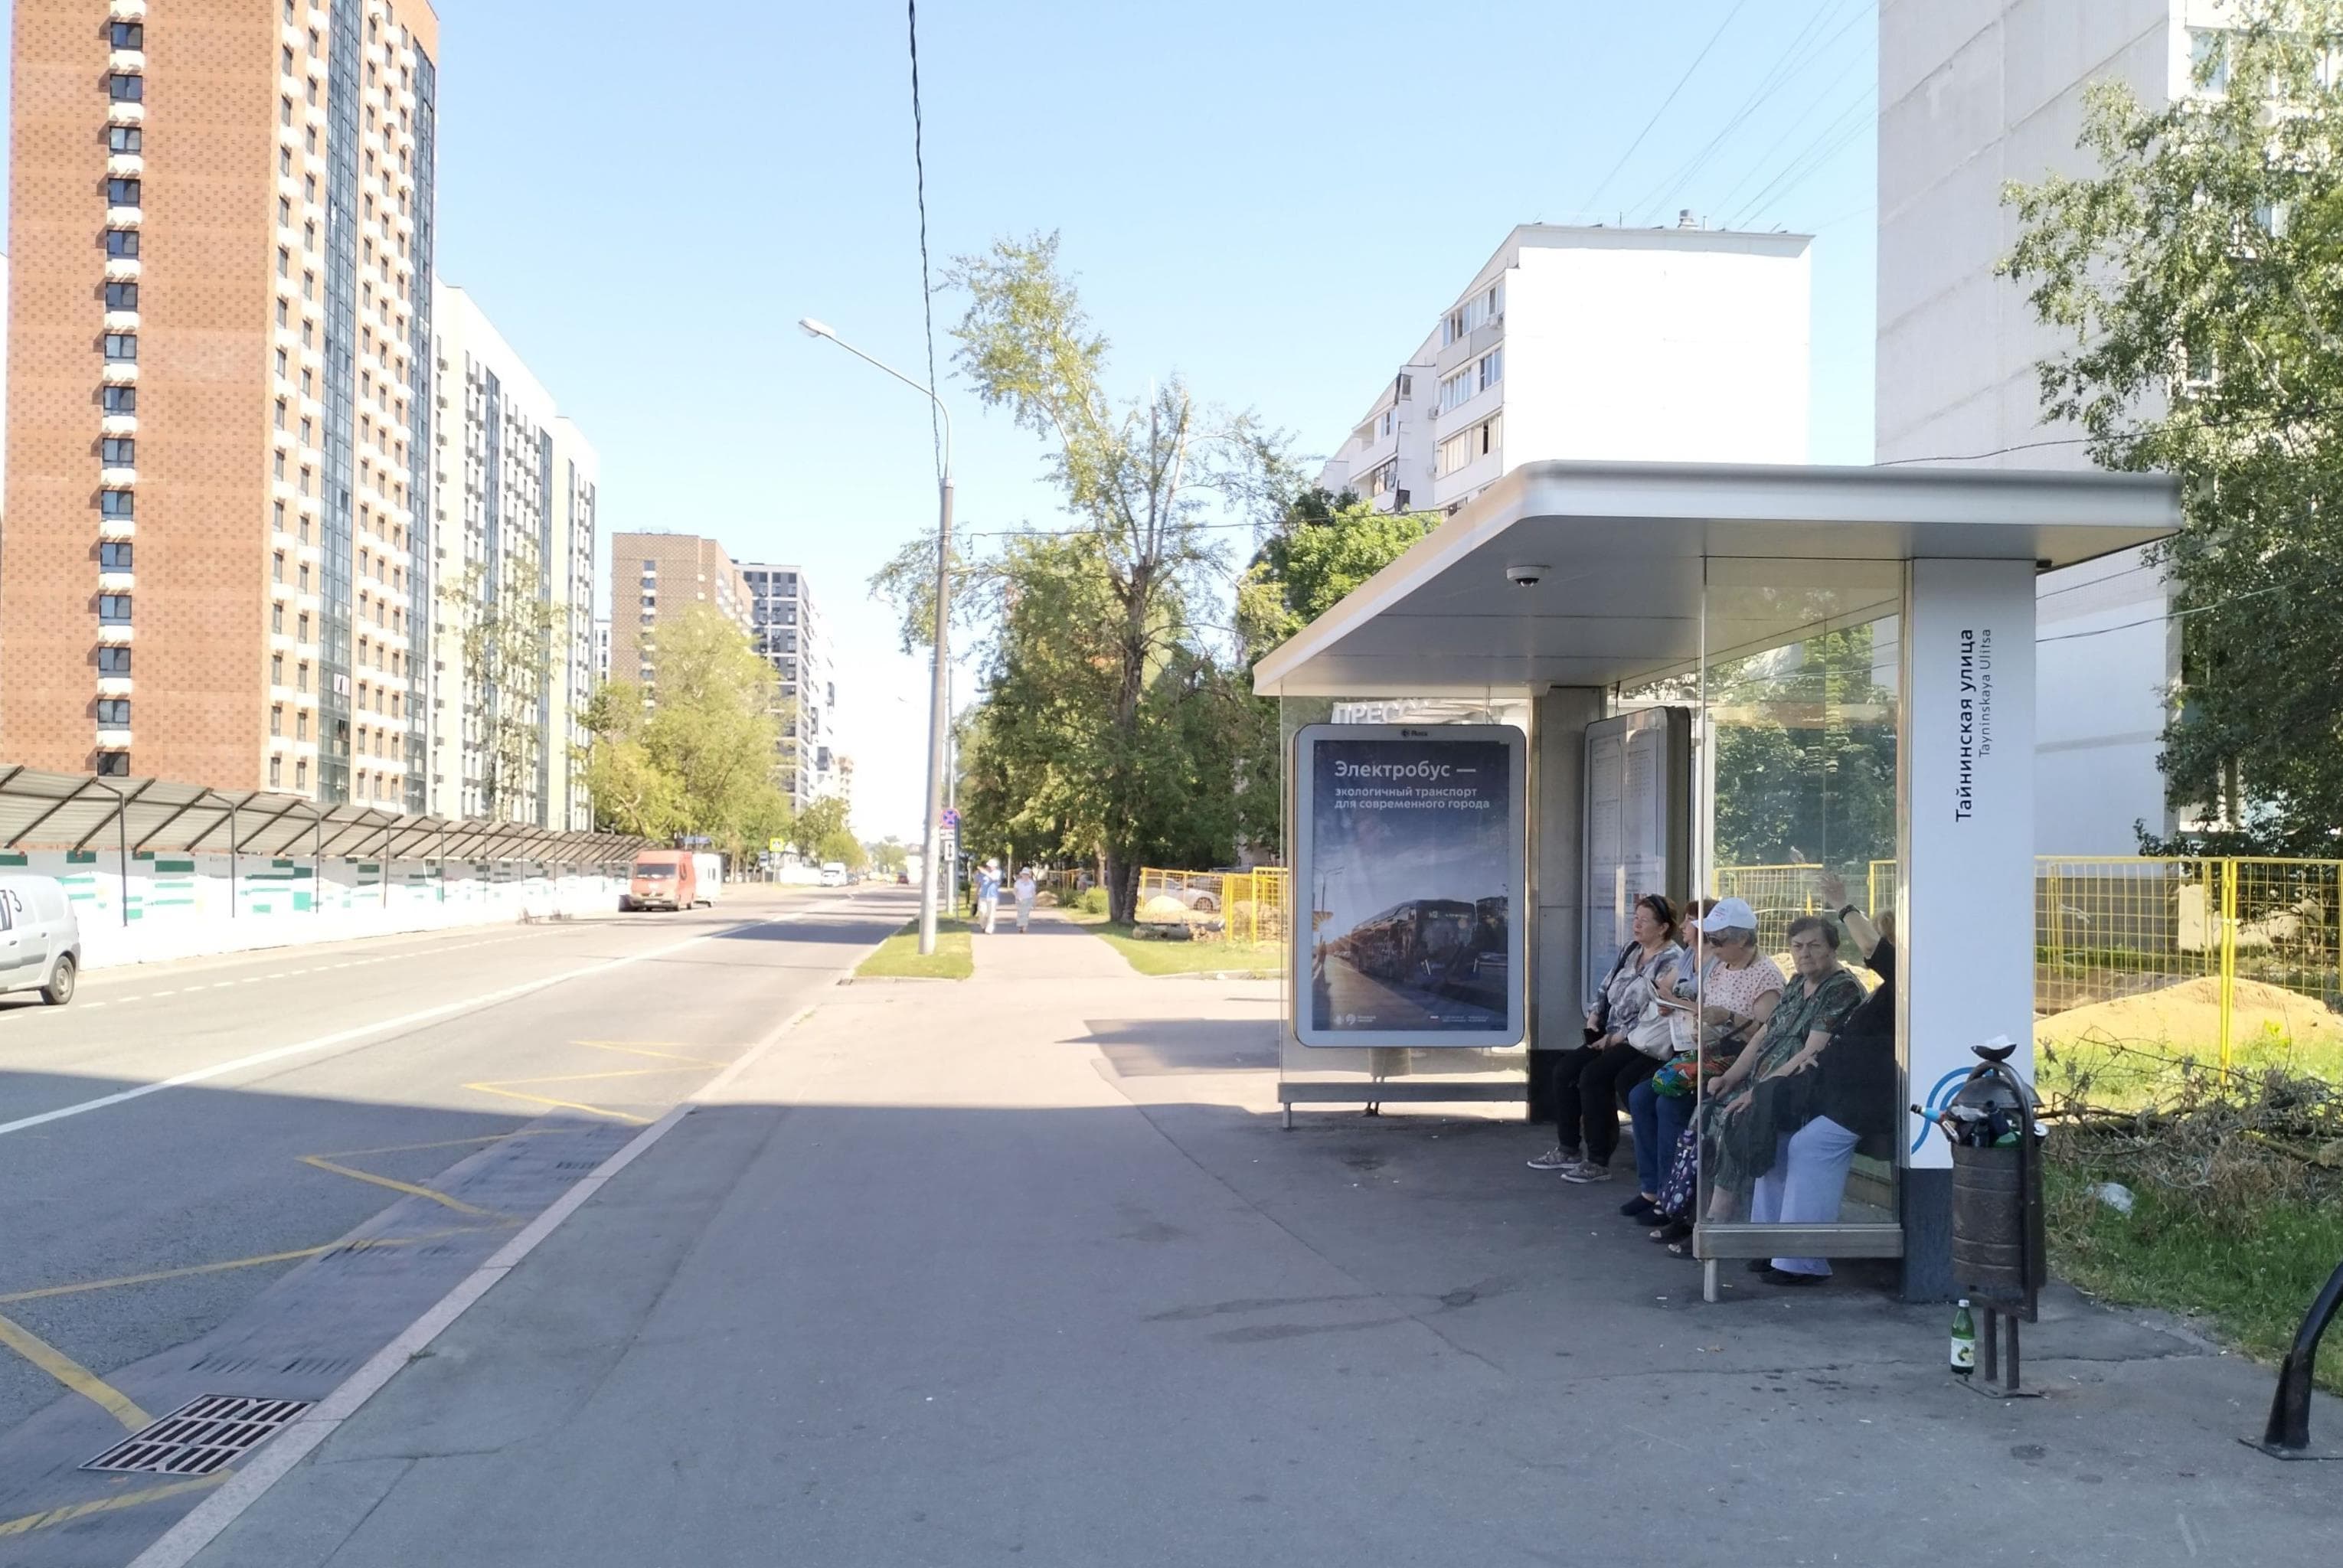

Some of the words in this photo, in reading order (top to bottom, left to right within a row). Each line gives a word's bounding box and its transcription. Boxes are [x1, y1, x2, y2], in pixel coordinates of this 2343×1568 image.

[1961, 629, 1976, 692] улица
[1979, 629, 1991, 670] Ulitsa
[1979, 674, 1994, 758] Tayninskaya
[1335, 760, 1450, 781] Электробус
[1956, 699, 1972, 822] Тайнинская
[1335, 786, 1412, 797] экологичный
[1416, 788, 1477, 798] транспорт
[1335, 800, 1356, 810] для
[1360, 802, 1445, 810] современного
